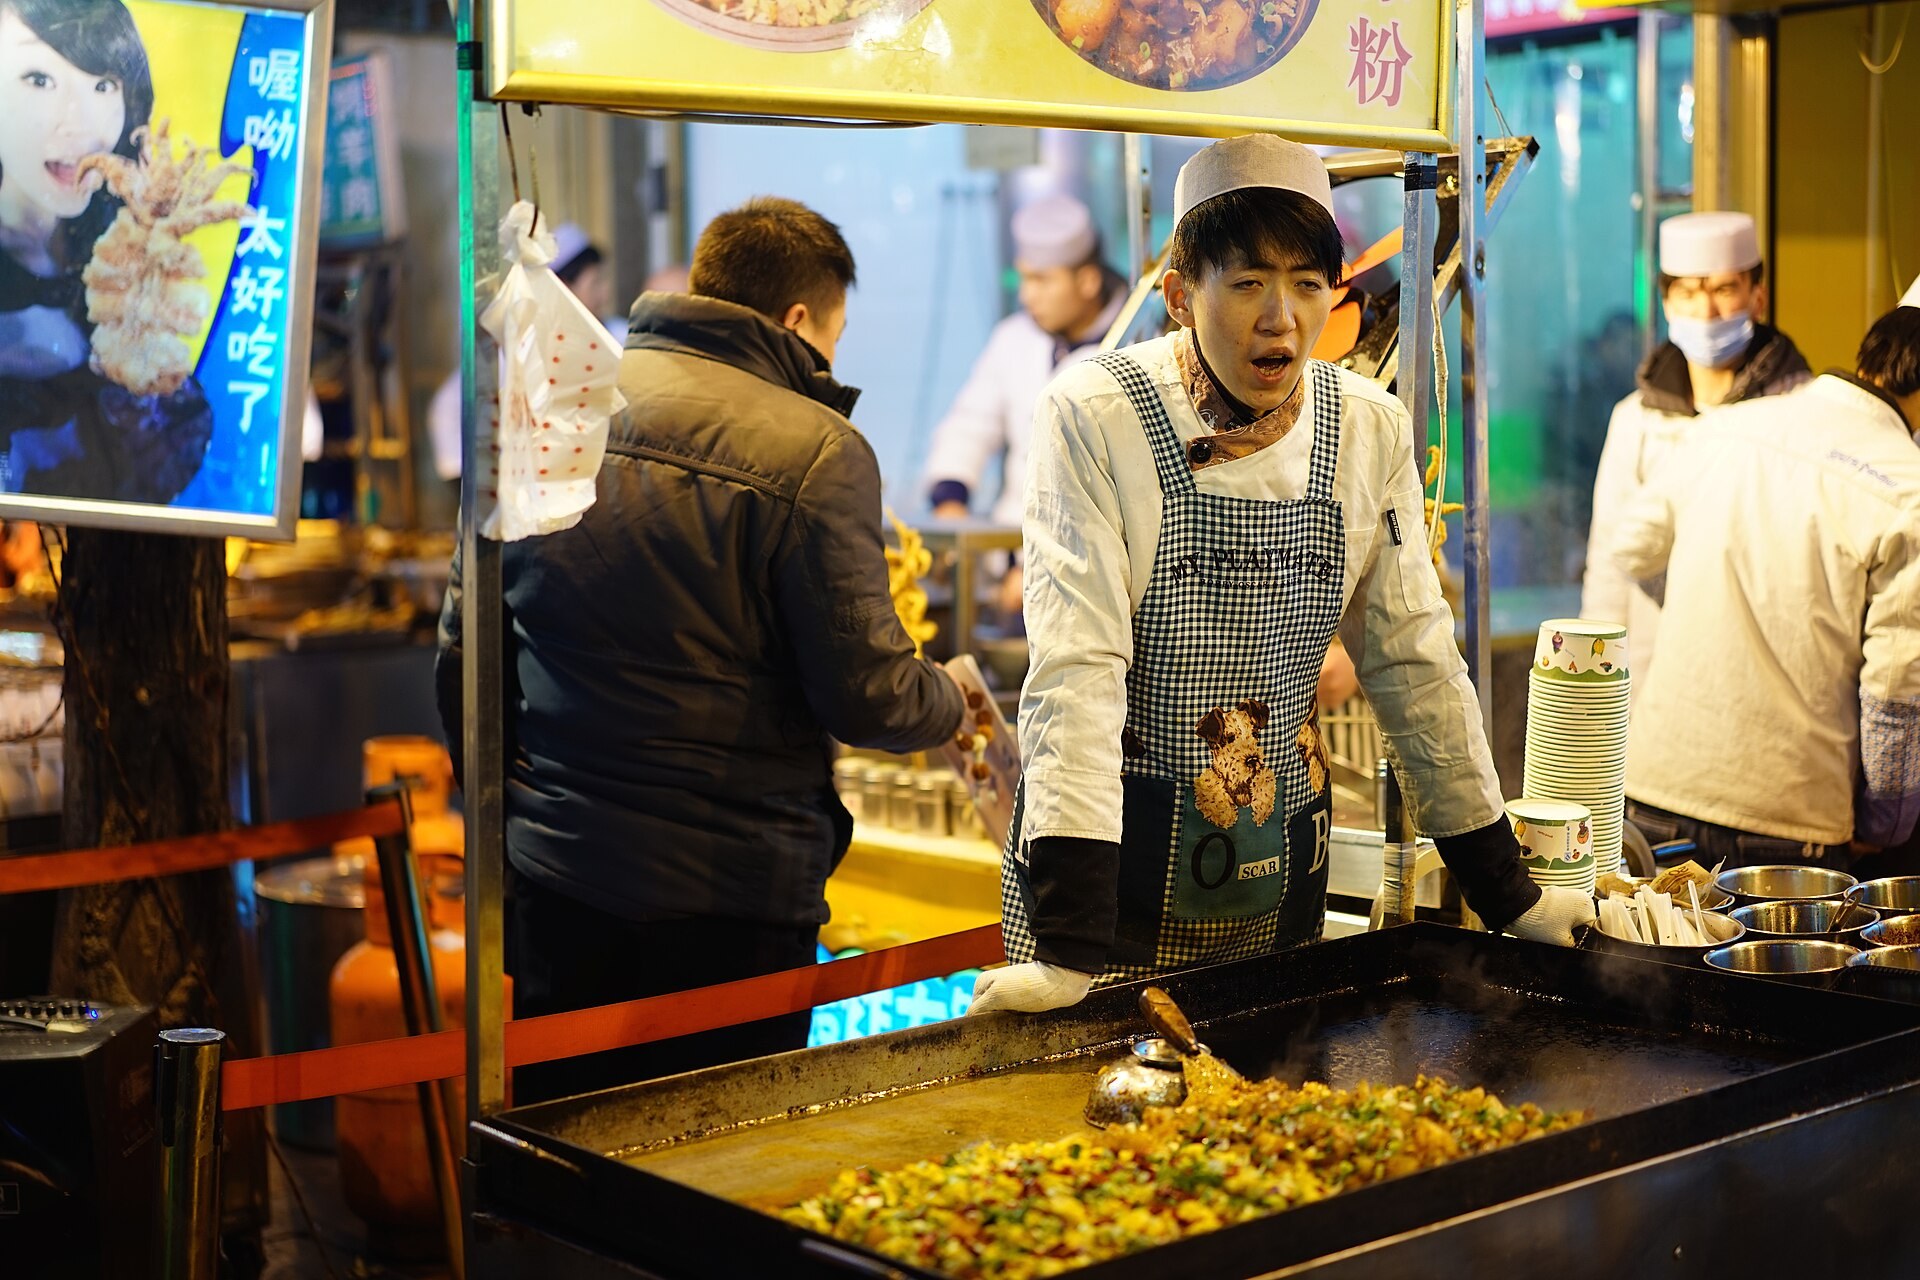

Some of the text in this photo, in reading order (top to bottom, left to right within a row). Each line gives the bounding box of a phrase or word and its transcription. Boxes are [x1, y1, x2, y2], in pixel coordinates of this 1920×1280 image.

[1169, 547, 1335, 586] MY PLAYMATE
[1308, 808, 1330, 875] B
[1241, 860, 1277, 879] SCAR
